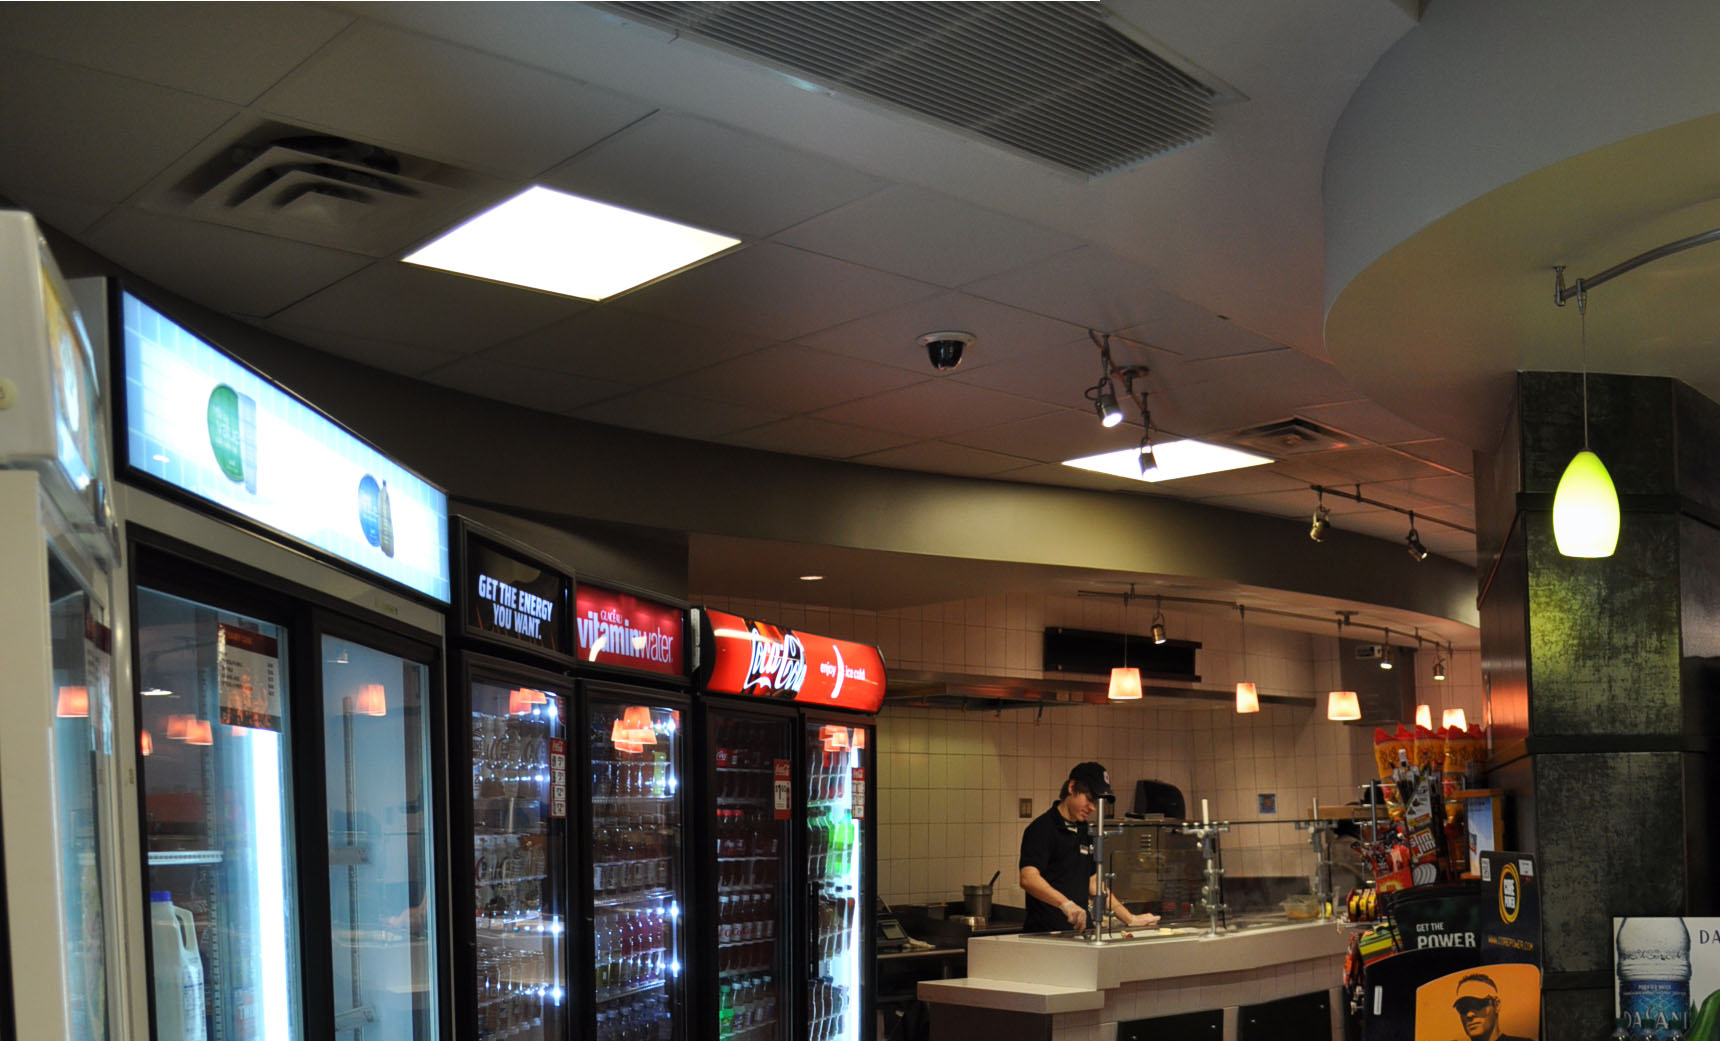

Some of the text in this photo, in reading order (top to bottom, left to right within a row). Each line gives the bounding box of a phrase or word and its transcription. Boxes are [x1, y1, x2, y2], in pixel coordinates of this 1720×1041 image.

[478, 574, 553, 622] GET THE ENERGY
[493, 603, 542, 640] YOU WANT.
[743, 627, 807, 692] Coca-Cola
[820, 662, 837, 678] enjoy
[845, 665, 866, 681] ice cold
[1503, 878, 1515, 896] CORE
[1416, 922, 1444, 932] GET THE
[1417, 932, 1476, 949] POWER
